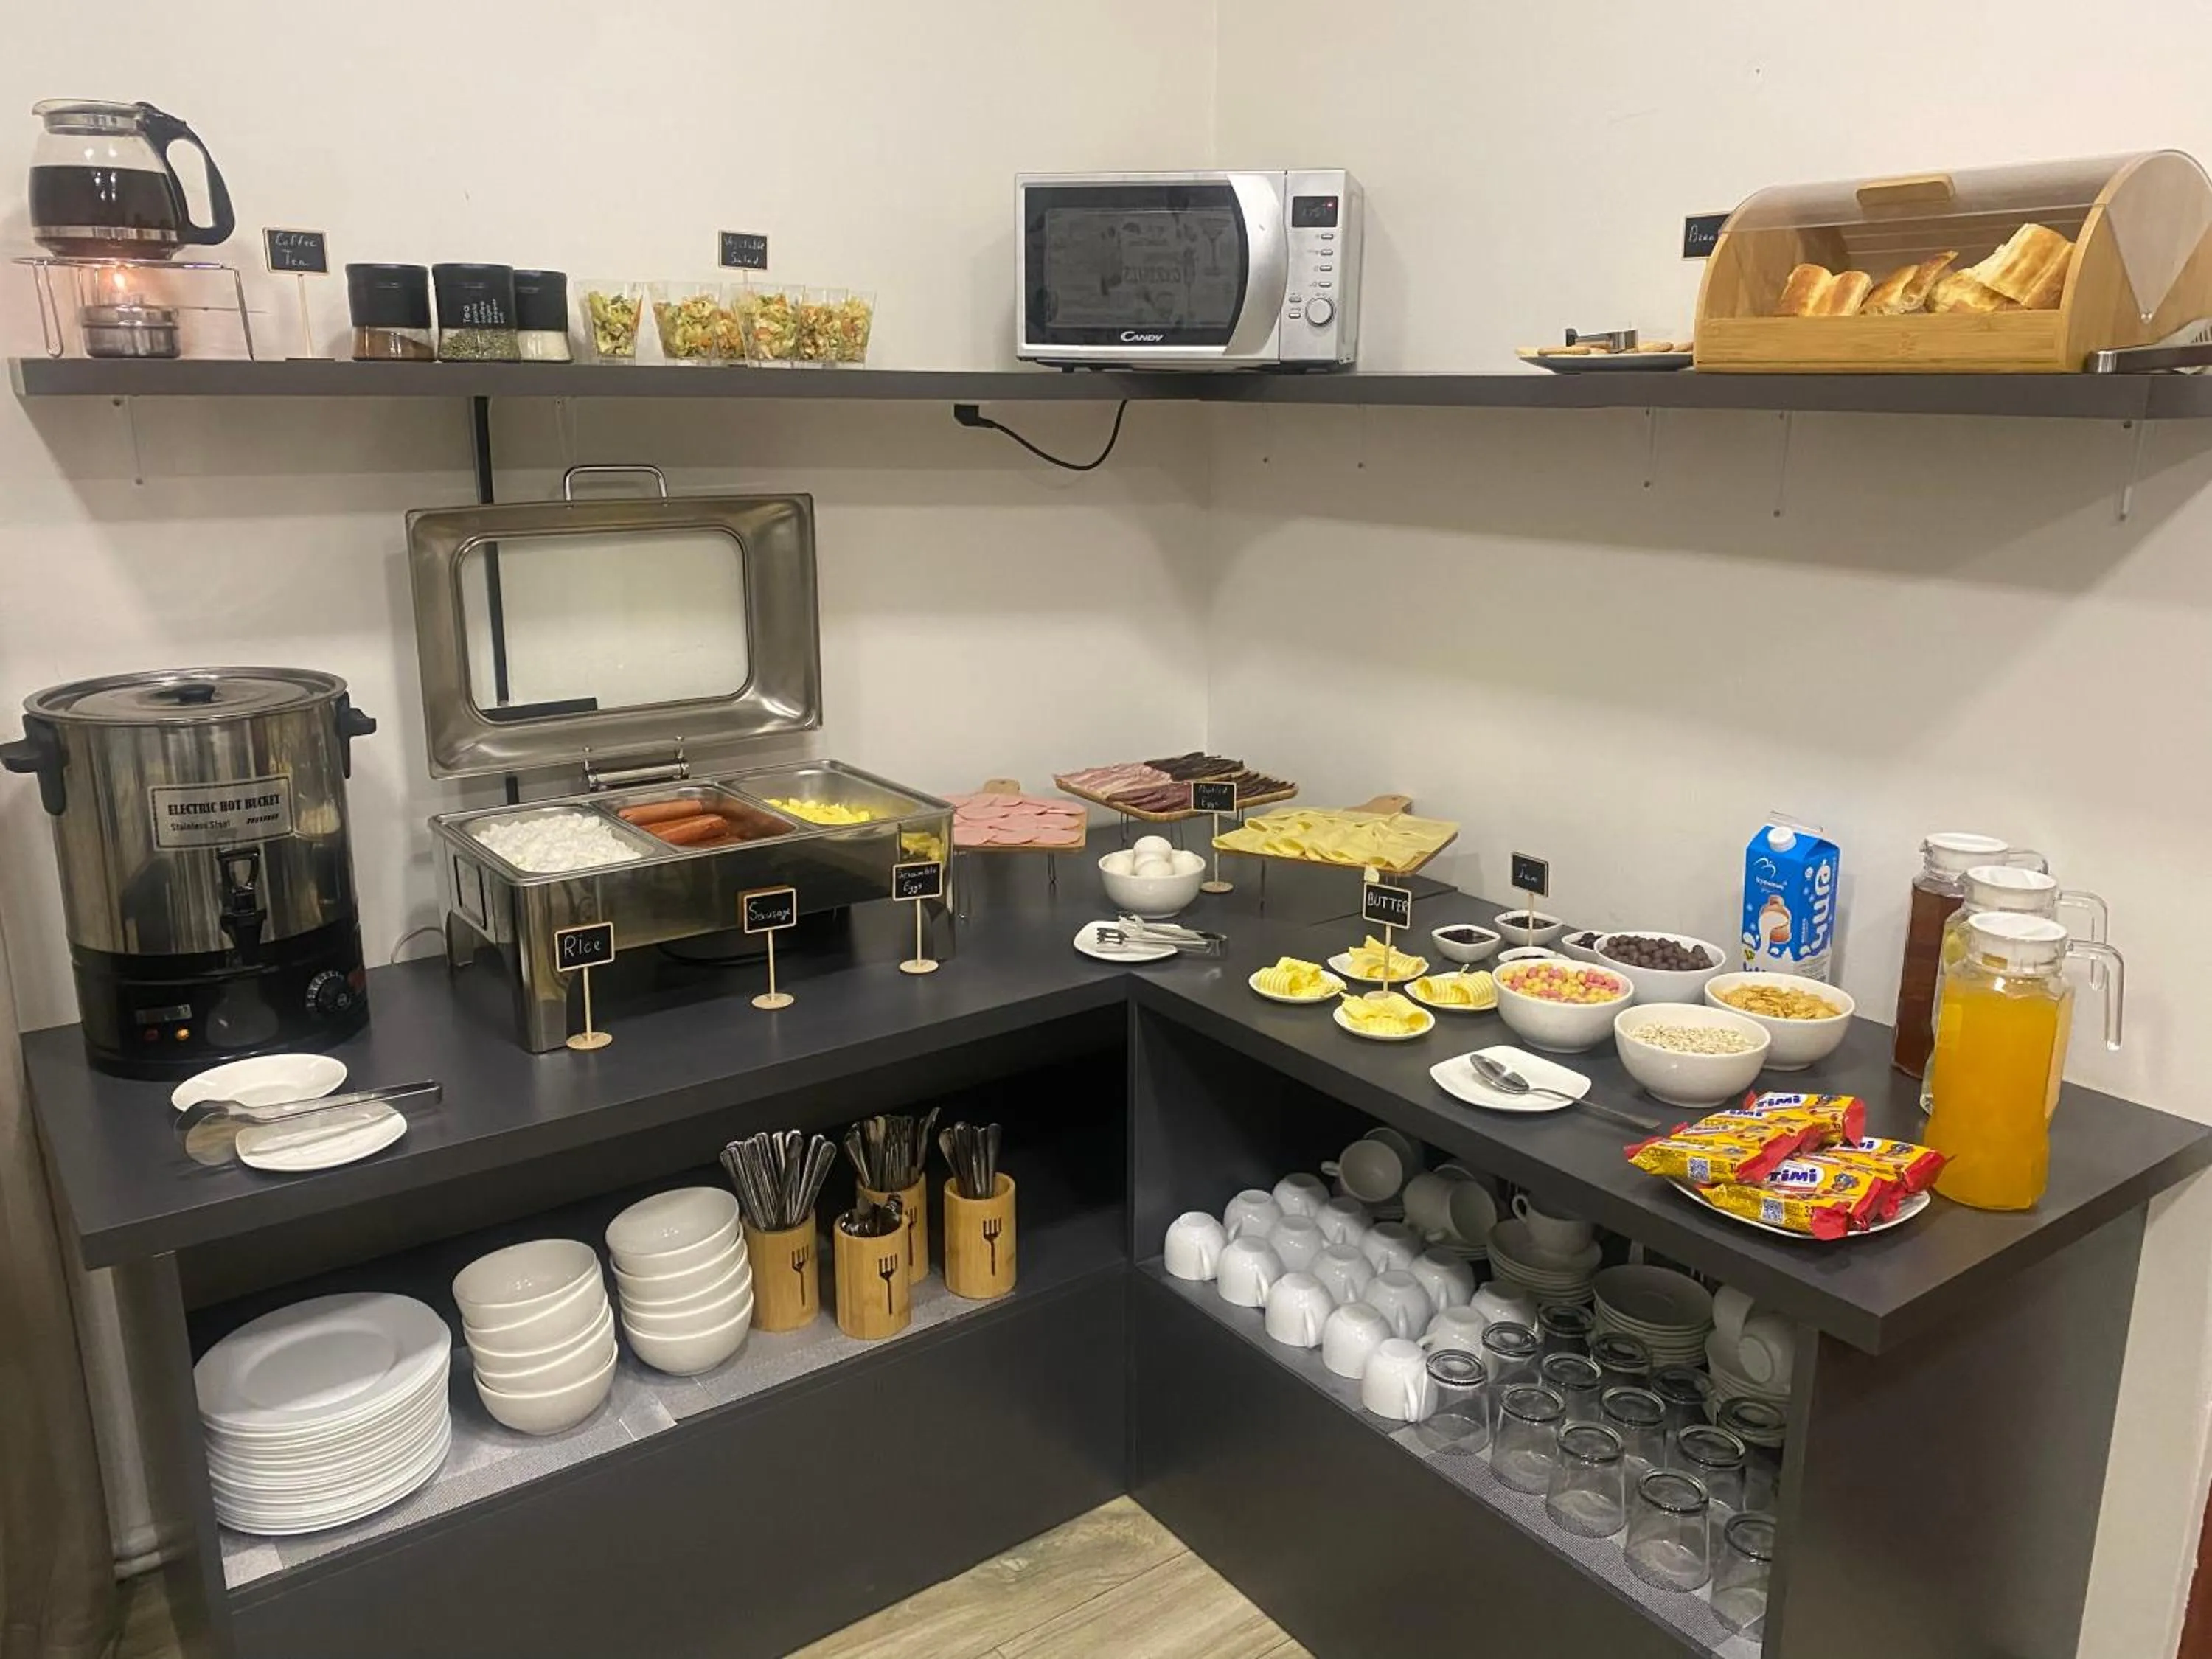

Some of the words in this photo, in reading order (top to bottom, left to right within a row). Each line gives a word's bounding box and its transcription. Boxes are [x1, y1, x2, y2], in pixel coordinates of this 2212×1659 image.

[1688, 223, 1715, 243] Brea
[282, 248, 308, 266] Tea
[167, 801, 217, 815] ELECTRIC
[219, 799, 241, 813] HOT
[244, 794, 280, 810] BUCKET
[1368, 891, 1408, 913] BUTTER
